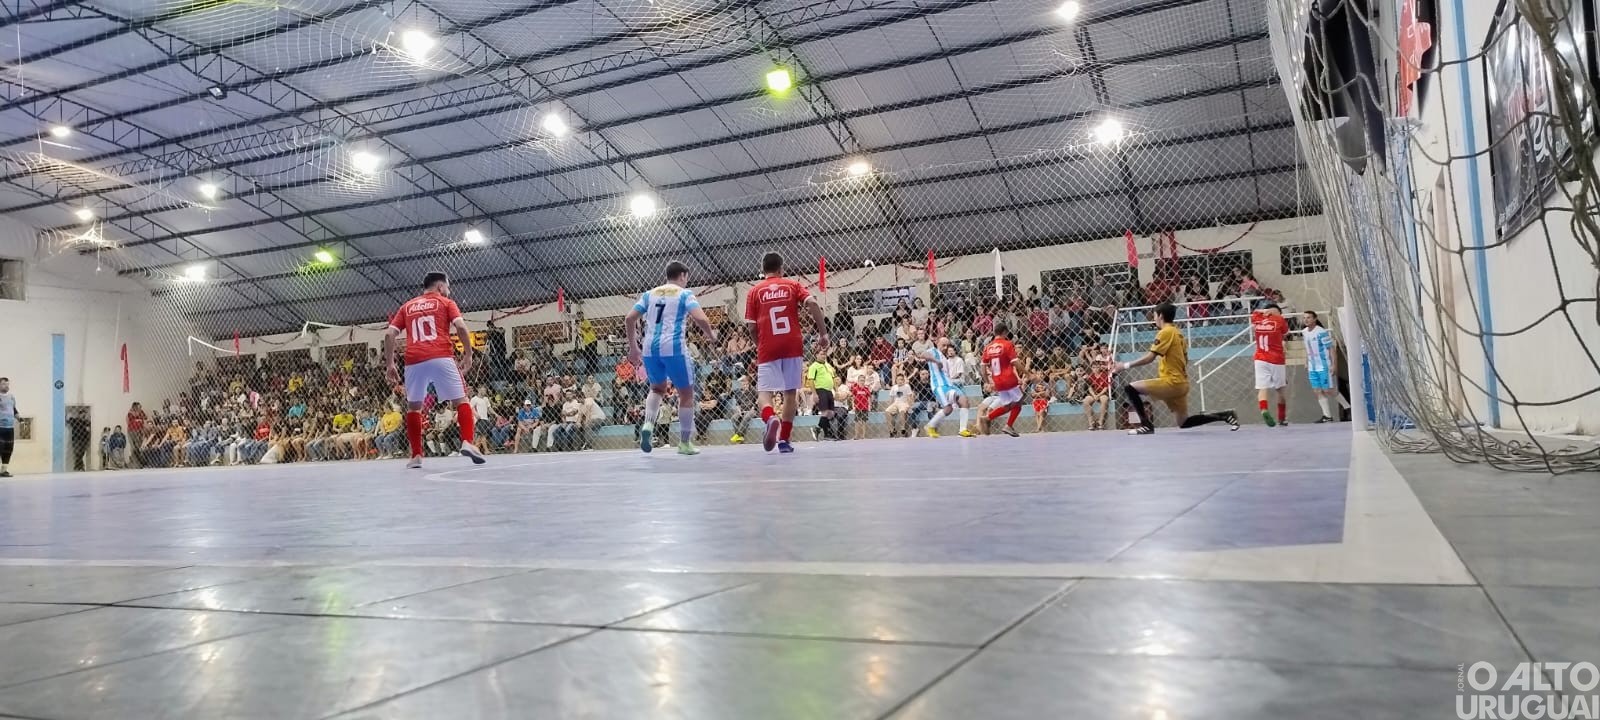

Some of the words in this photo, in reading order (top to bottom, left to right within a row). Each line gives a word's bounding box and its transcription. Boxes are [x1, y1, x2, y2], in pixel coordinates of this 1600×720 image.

[655, 303, 666, 324] 7
[769, 305, 791, 335] 6
[411, 315, 438, 343] 10
[1258, 335, 1269, 352] 11
